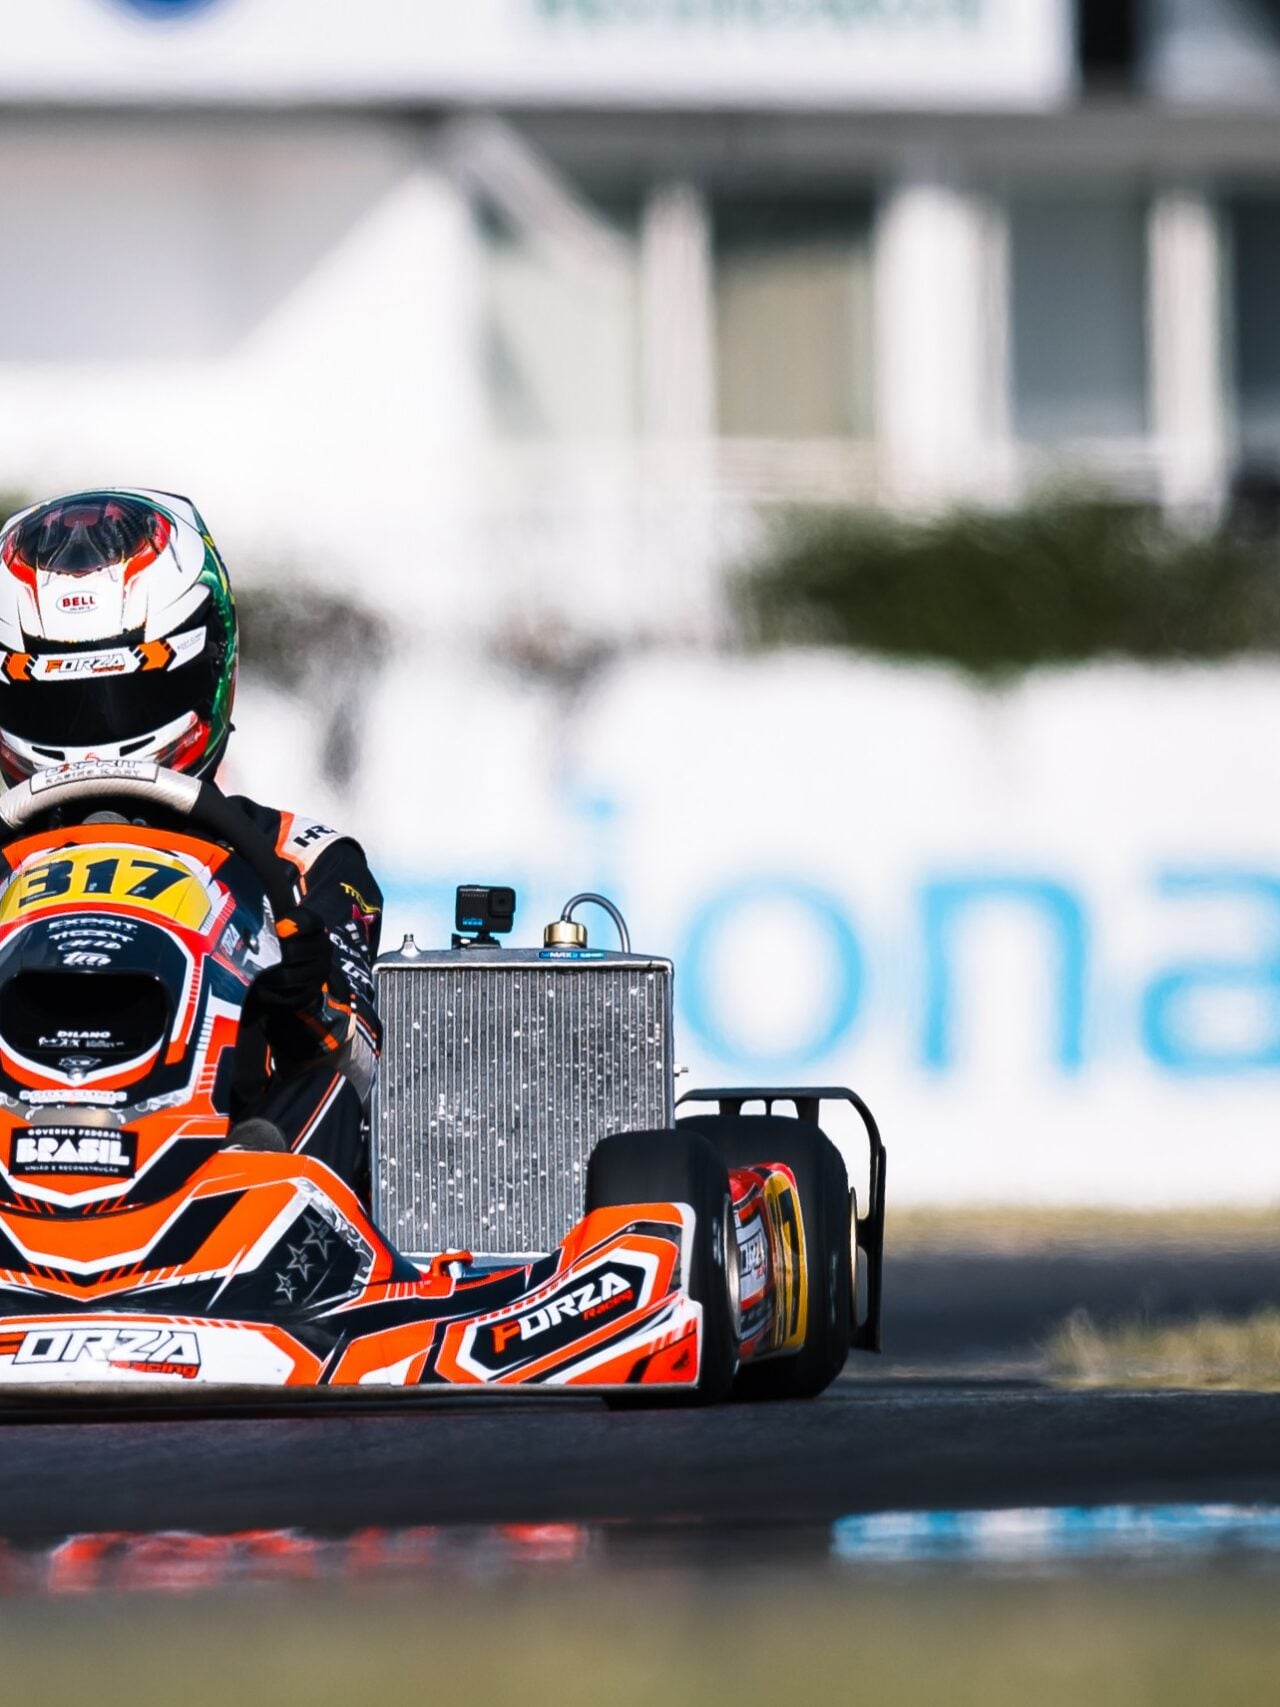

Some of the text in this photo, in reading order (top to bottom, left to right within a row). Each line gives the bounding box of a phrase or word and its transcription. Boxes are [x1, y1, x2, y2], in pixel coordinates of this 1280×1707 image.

[62, 595, 96, 608] BELL
[45, 653, 126, 673] FORZA
[19, 858, 191, 909] 317
[27, 1128, 122, 1140] GOVERNO FEDERAL
[16, 1137, 131, 1166] BRASIL
[490, 1271, 632, 1354] FORZA
[582, 1288, 634, 1321] Racing
[108, 1360, 201, 1379] Racing
